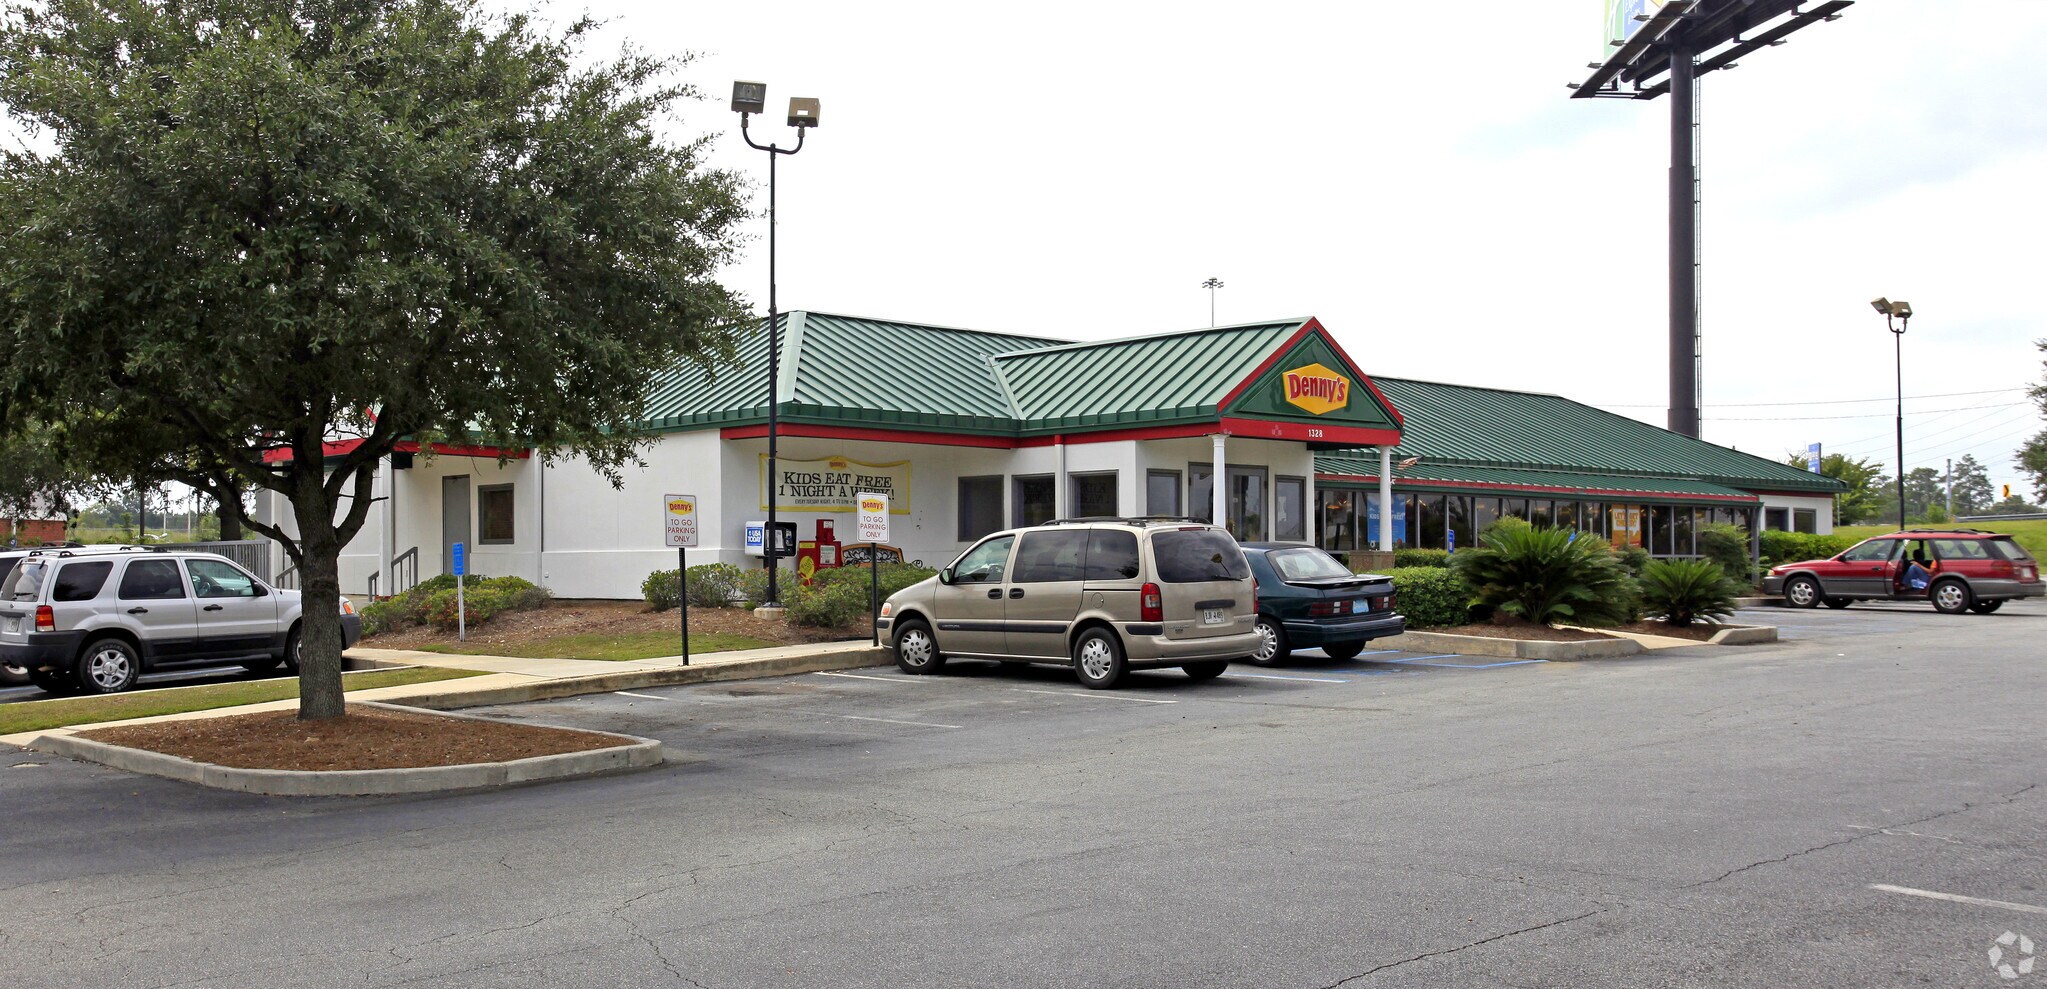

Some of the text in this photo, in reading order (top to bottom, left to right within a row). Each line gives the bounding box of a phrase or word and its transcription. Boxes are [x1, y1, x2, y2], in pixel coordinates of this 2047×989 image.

[1286, 373, 1346, 403] Denny's
[1308, 429, 1323, 438] 1328
[783, 472, 893, 488] KIDS EAT FREE
[779, 485, 786, 496] 1
[790, 485, 836, 497] NIGHT
[839, 486, 848, 497] A
[669, 503, 692, 512] Denny's
[862, 502, 884, 510] Denny's
